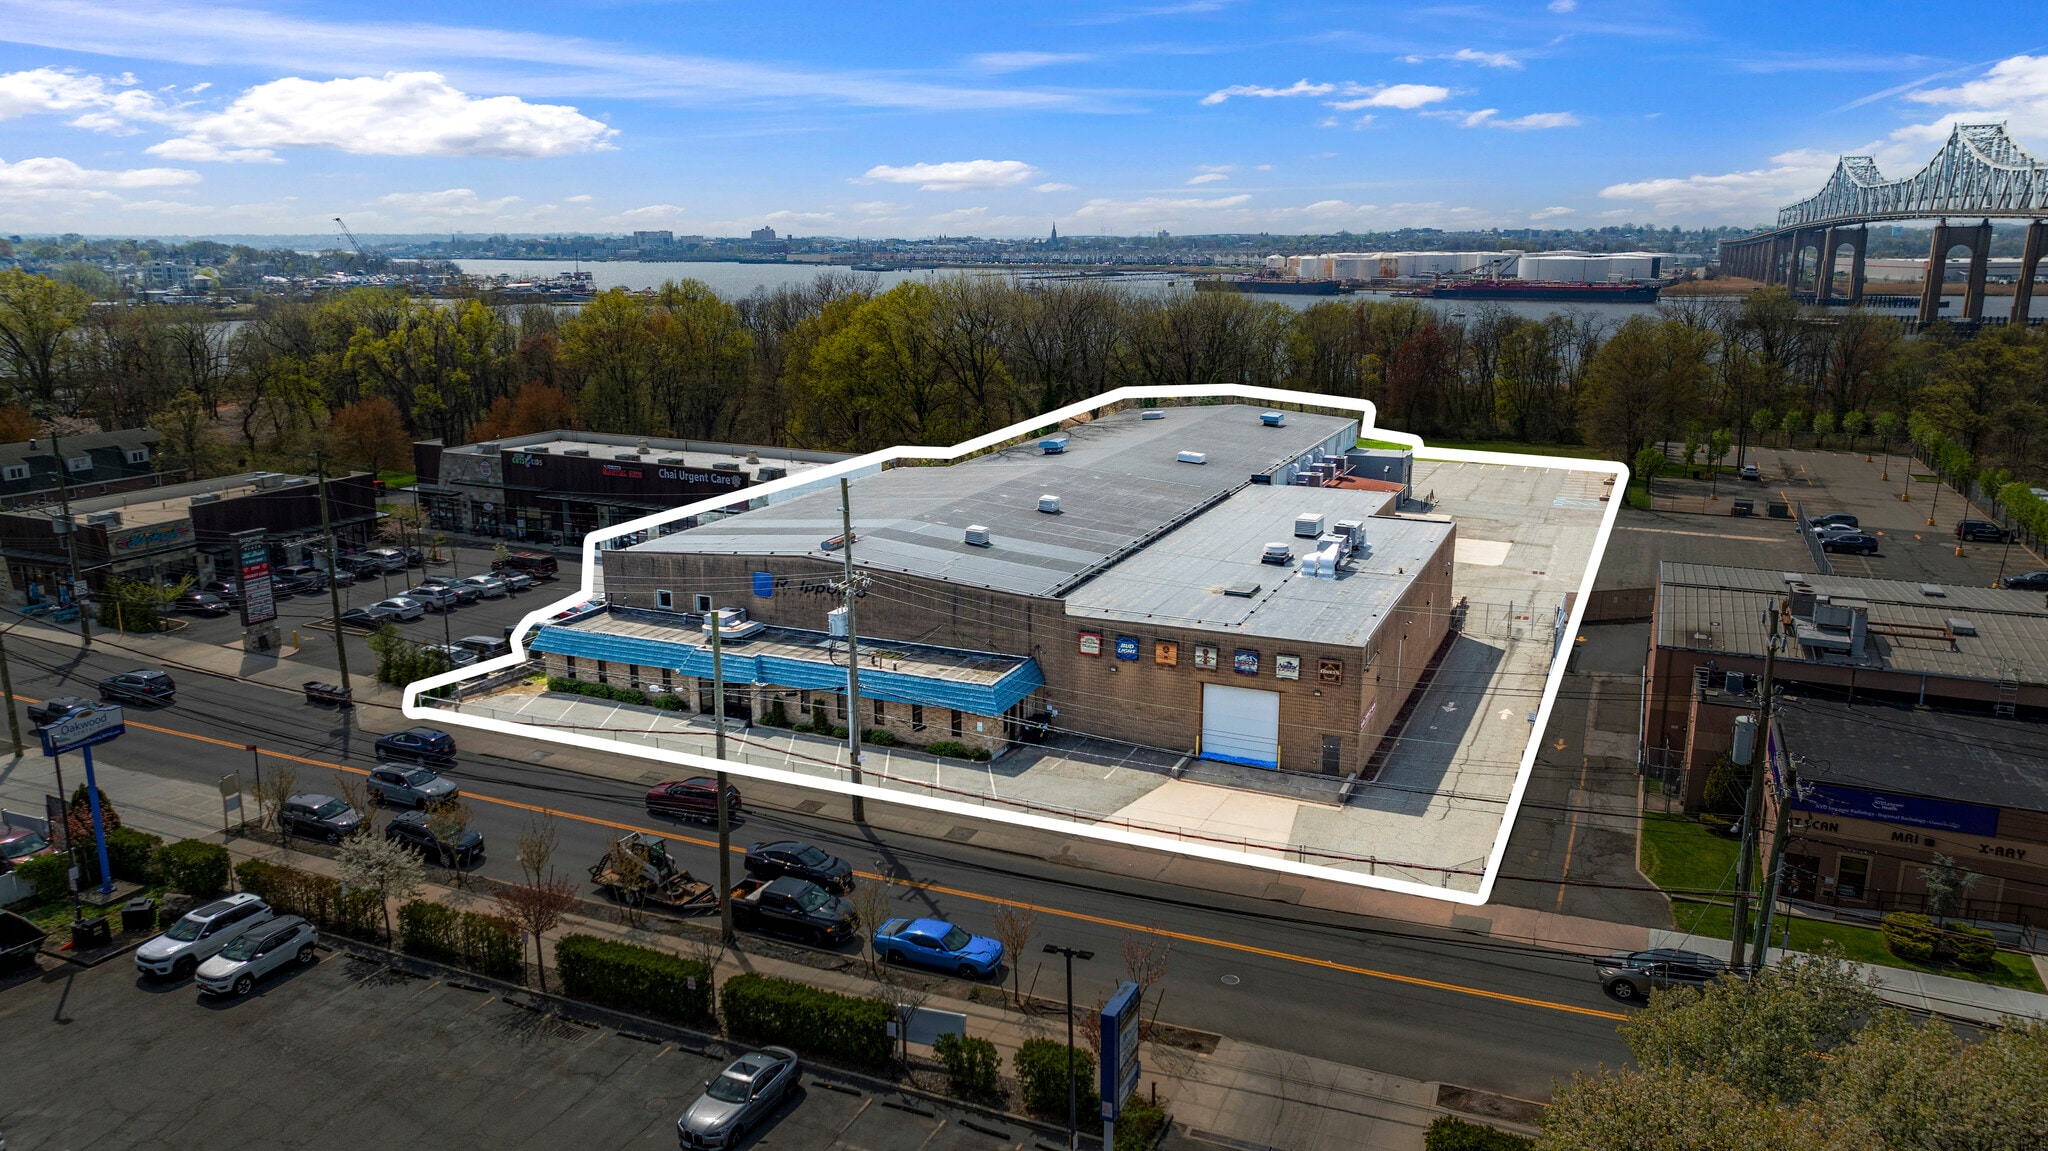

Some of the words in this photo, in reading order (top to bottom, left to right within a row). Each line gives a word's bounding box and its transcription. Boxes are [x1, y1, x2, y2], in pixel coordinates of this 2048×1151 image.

[658, 468, 677, 480] Chai
[678, 470, 709, 484] Urgent
[710, 473, 731, 485] Care
[61, 713, 107, 735] Oakwood
[1804, 819, 1839, 832] SCAN
[1891, 832, 1919, 844] MRI
[1979, 843, 2026, 859] X-RAY
